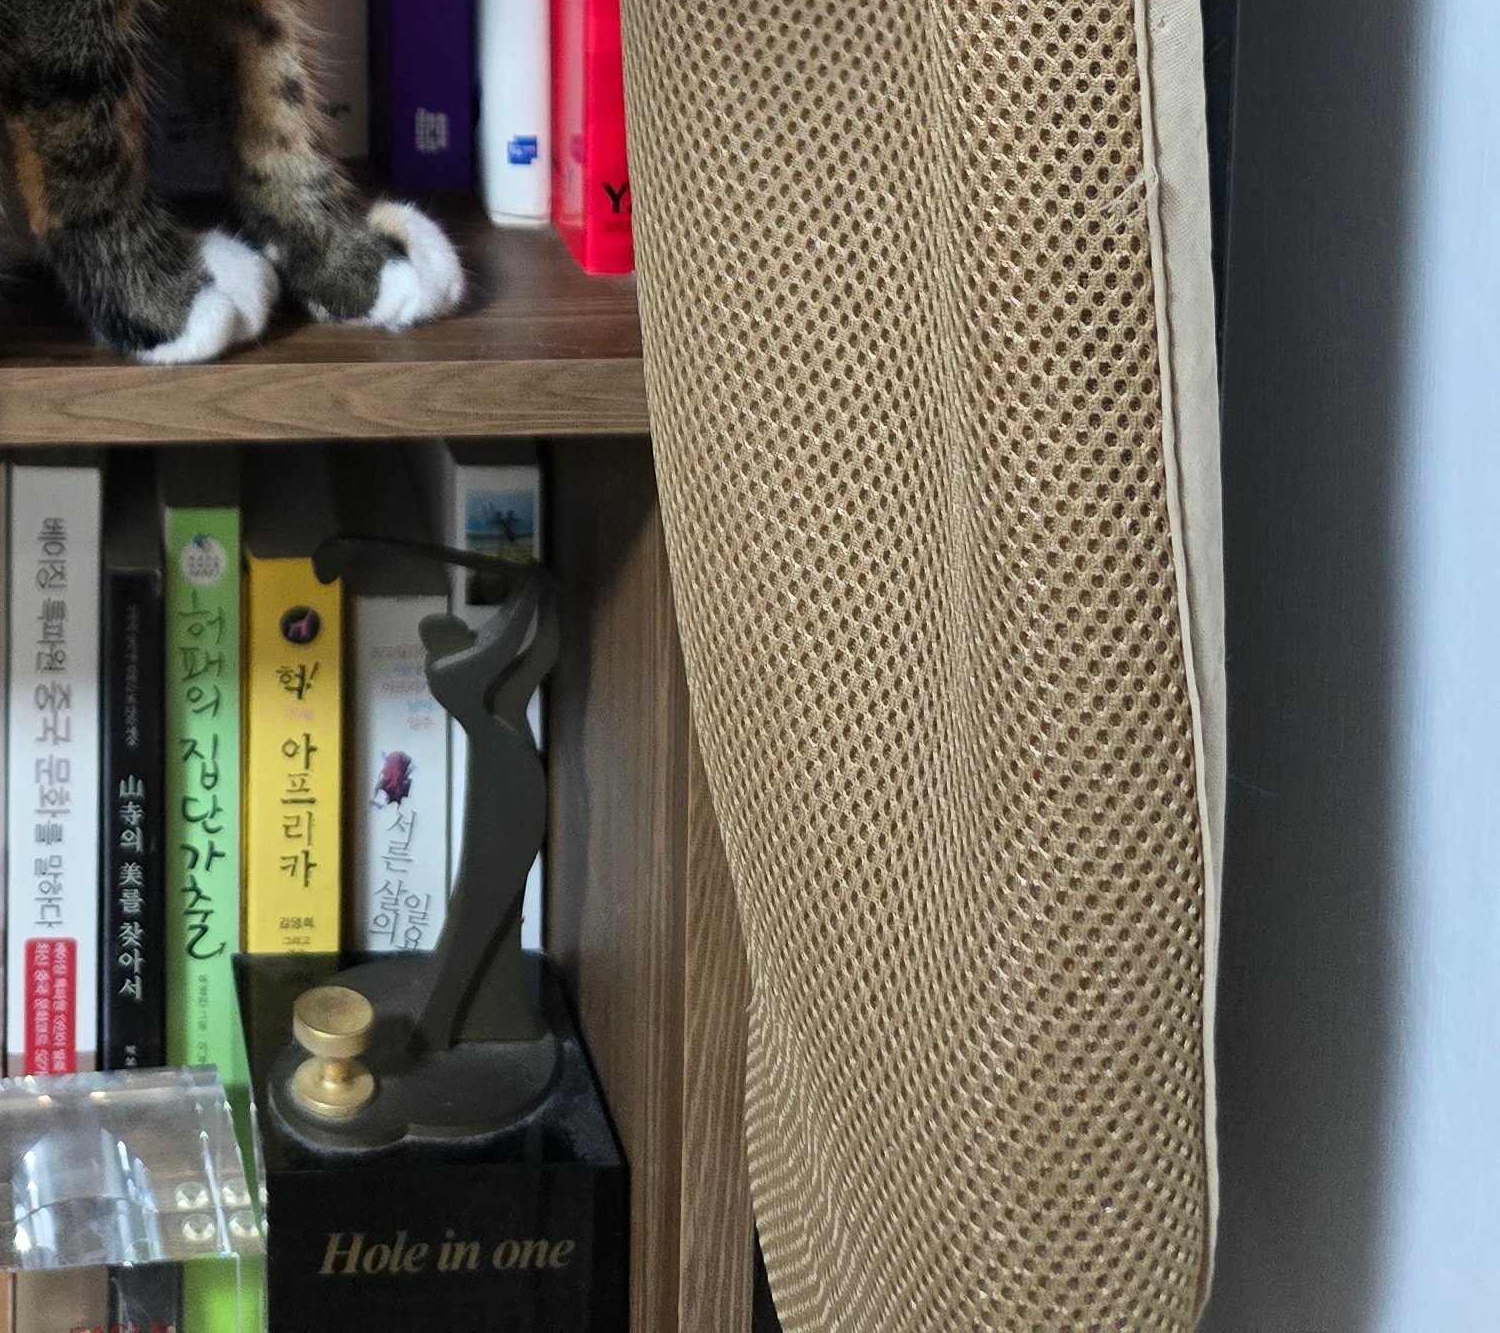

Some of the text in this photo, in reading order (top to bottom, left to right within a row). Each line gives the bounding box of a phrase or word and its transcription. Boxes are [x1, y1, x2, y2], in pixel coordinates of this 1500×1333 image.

[32, 516, 74, 928] 베이징 특파원 중국 문화를 말하다
[278, 732, 319, 889] 아프리카
[380, 809, 418, 874] 서른
[117, 918, 146, 1002] 찾아서
[318, 1230, 577, 1277] Hole in one
